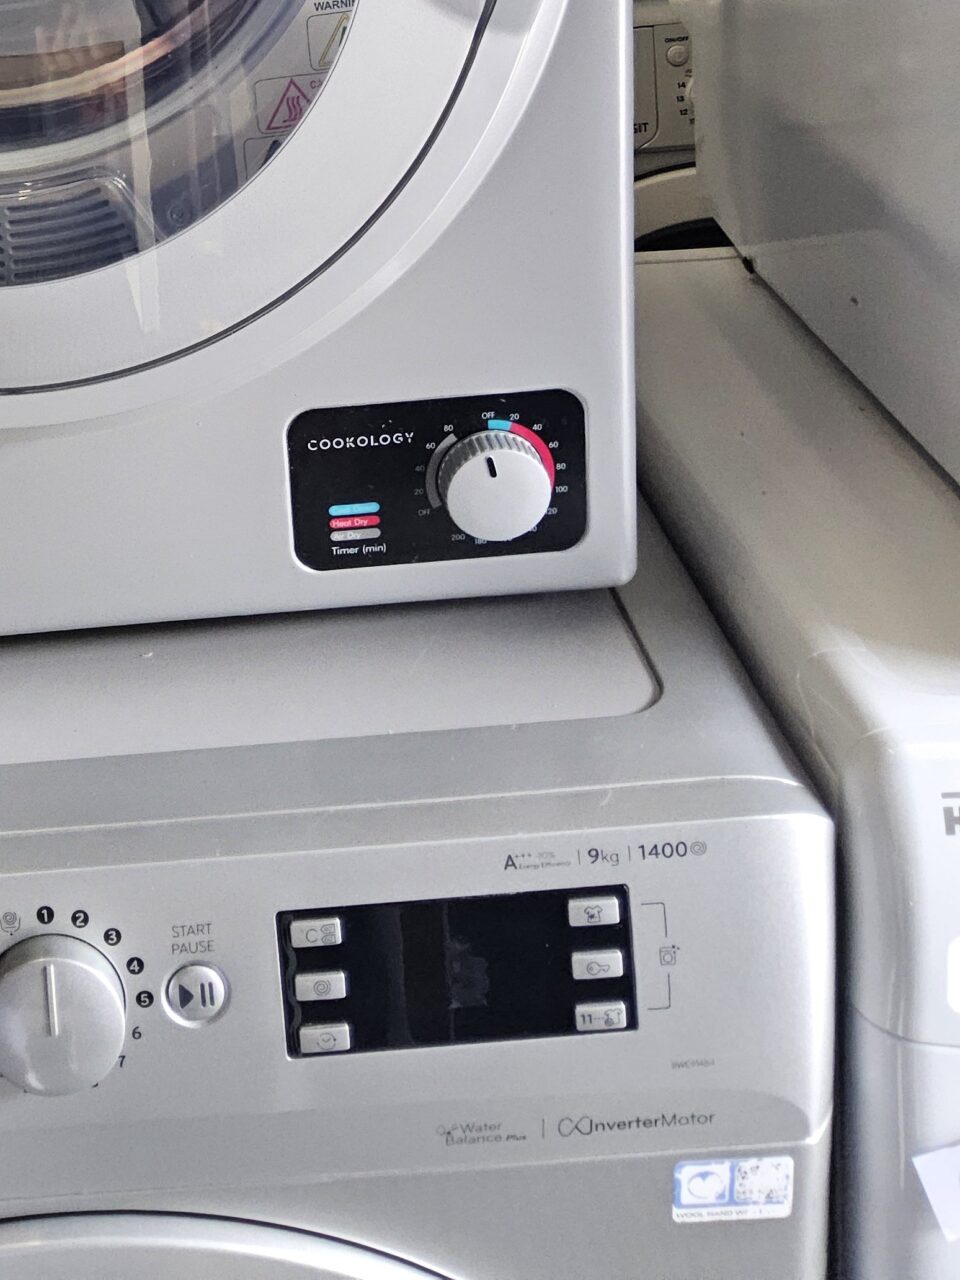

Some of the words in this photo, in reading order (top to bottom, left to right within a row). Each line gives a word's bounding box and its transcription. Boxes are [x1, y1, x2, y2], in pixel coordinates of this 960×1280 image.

[481, 412, 495, 420] OFF
[509, 413, 520, 421] 20
[443, 424, 454, 432] 80
[532, 423, 542, 431] 40
[307, 432, 414, 451] COOKOLOGY
[425, 442, 436, 450] 60
[548, 441, 559, 449] 60
[556, 462, 566, 471] 80
[555, 485, 568, 493] 100
[418, 508, 431, 516] OFF
[546, 507, 557, 515] 20
[451, 533, 465, 541] 200
[331, 546, 359, 556] Timer
[362, 542, 387, 555] (min)
[638, 841, 688, 861] 1400
[587, 847, 620, 866] 9kg
[171, 923, 214, 938] START
[171, 940, 216, 955] PAUSE
[132, 1026, 142, 1040] 6
[118, 1055, 126, 1068] 7
[460, 1122, 503, 1134] Water
[446, 1133, 502, 1147] Balance
